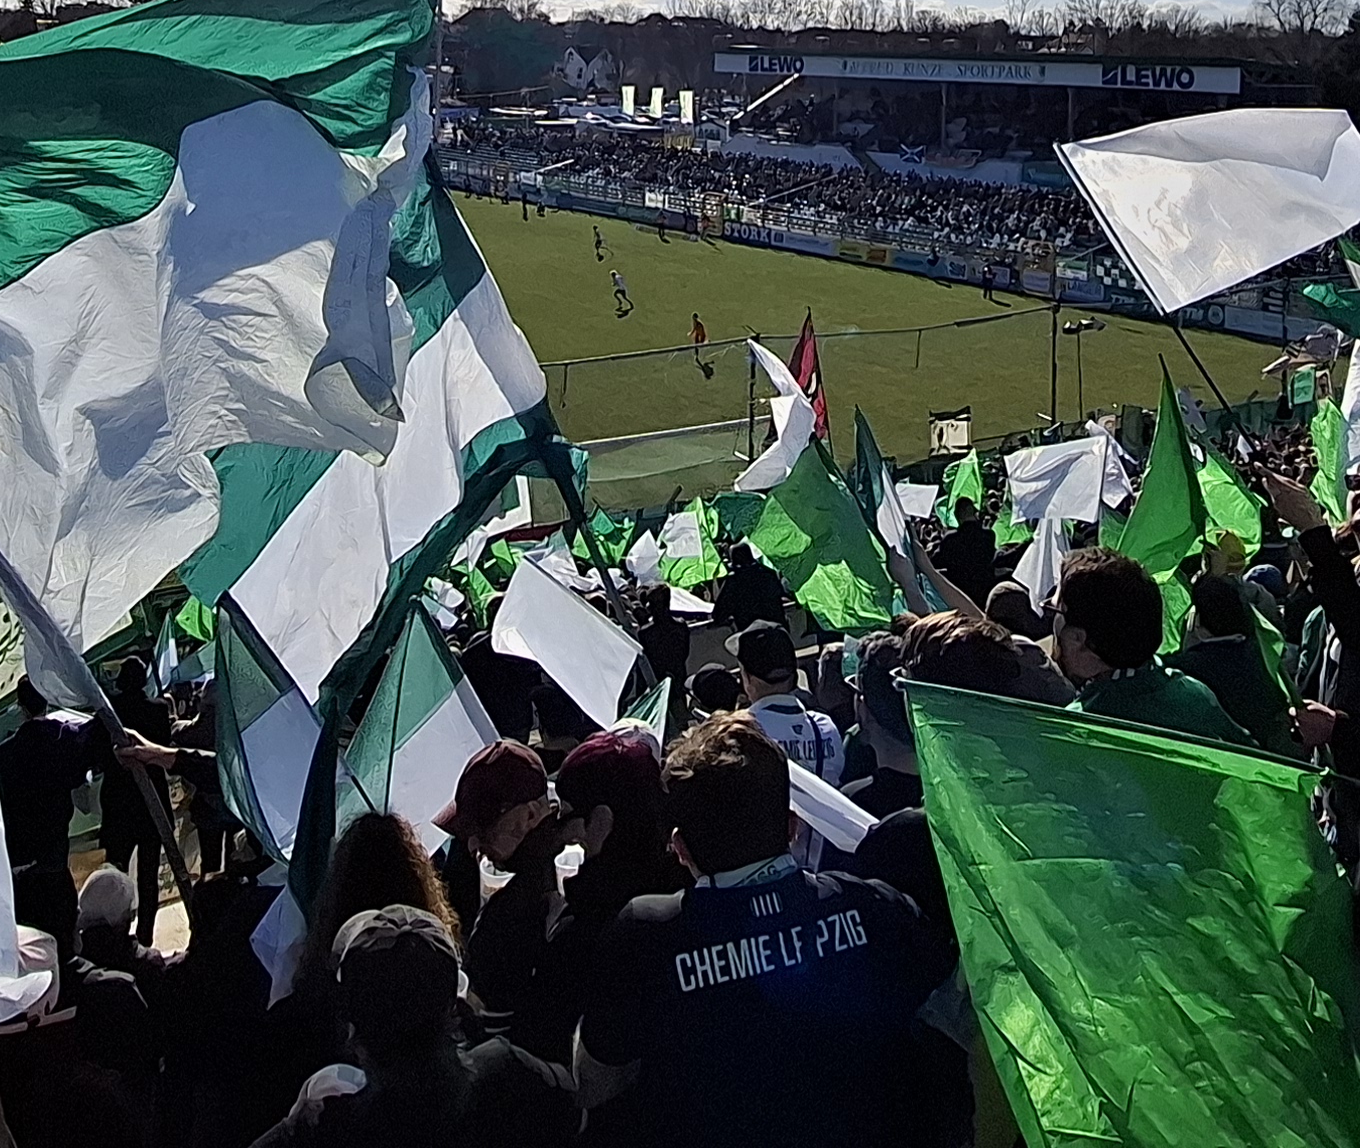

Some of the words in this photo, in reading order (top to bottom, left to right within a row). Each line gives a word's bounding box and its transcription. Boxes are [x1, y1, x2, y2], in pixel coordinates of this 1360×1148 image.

[760, 55, 805, 74] LEWO
[1120, 64, 1195, 90] LEWO
[723, 221, 771, 243] STORK
[675, 934, 776, 993] CHEMIE
